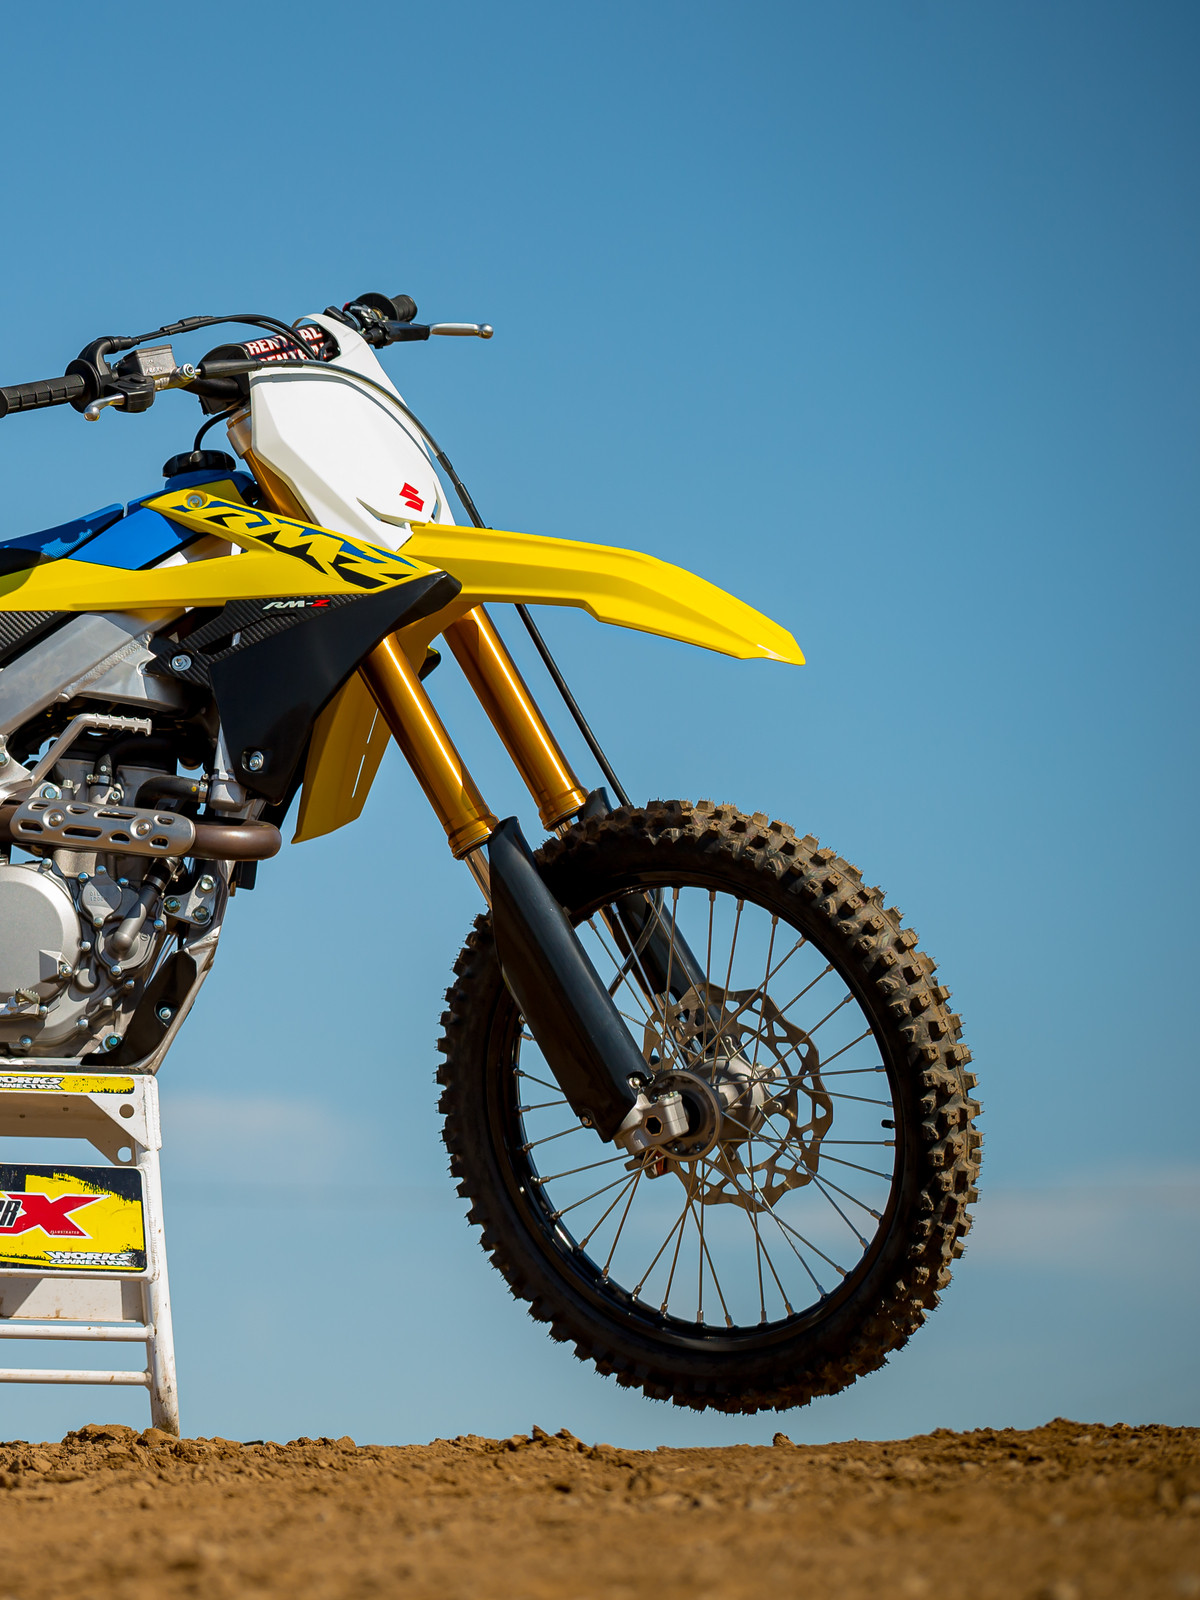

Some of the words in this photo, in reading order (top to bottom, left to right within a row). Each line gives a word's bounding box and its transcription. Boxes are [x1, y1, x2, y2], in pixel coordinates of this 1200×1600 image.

[244, 327, 323, 355] RENTAL
[262, 599, 331, 610] RM-Z
[44, 1251, 135, 1261] WORKS
[49, 1258, 135, 1267] CONNECTION
